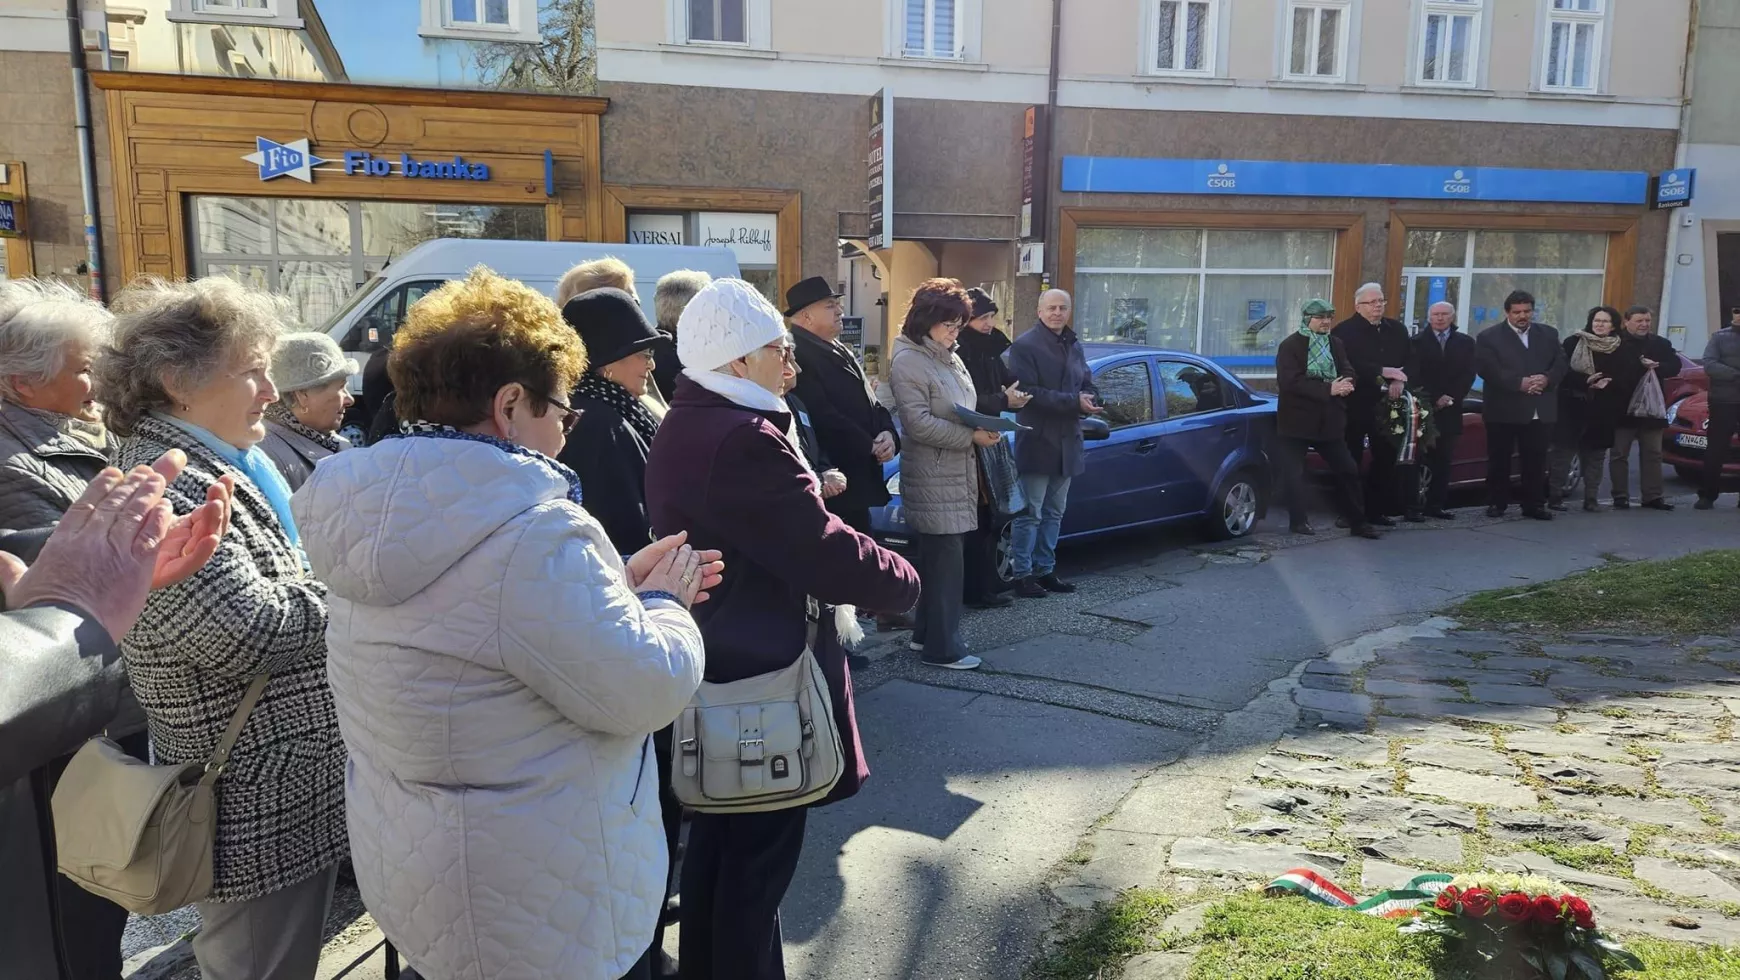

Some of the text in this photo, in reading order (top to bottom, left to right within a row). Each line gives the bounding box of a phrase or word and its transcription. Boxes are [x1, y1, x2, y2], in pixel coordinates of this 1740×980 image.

[268, 147, 300, 171] Fio
[344, 150, 490, 181] Fio banka
[704, 226, 736, 247] Joseph
